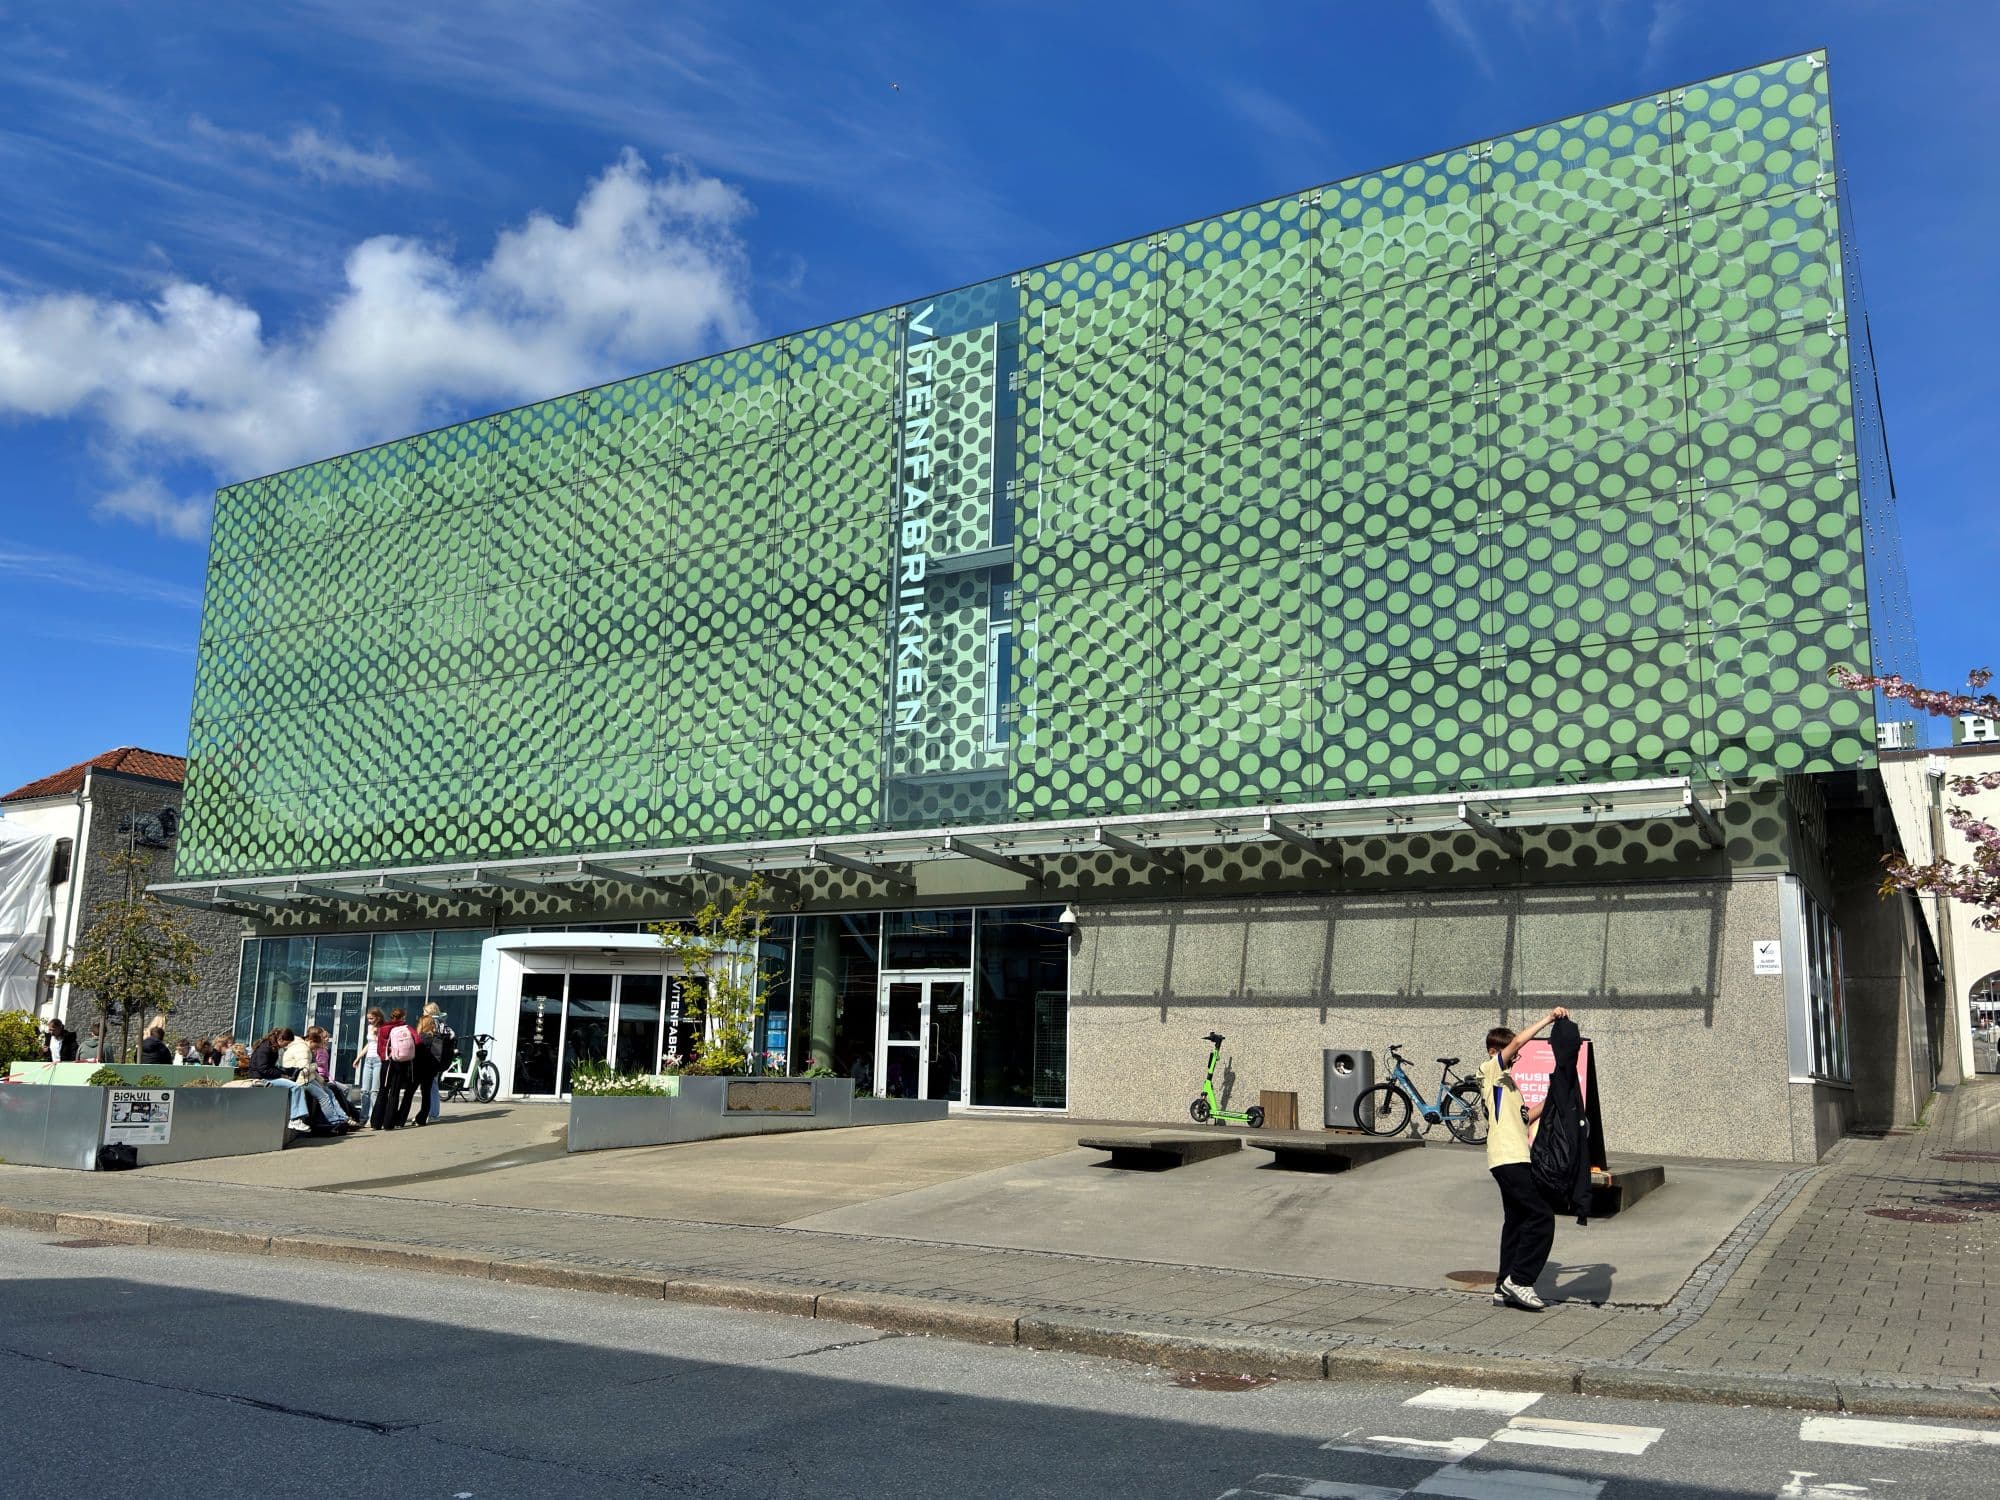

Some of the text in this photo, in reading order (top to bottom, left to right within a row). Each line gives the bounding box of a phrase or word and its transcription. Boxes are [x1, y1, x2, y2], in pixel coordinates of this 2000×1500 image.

[895, 303, 934, 732] VITENFABRIKKEN
[667, 981, 681, 1056] VITENFABR
[1514, 1072, 1550, 1081] MUSE
[1520, 1083, 1549, 1092] SCIE
